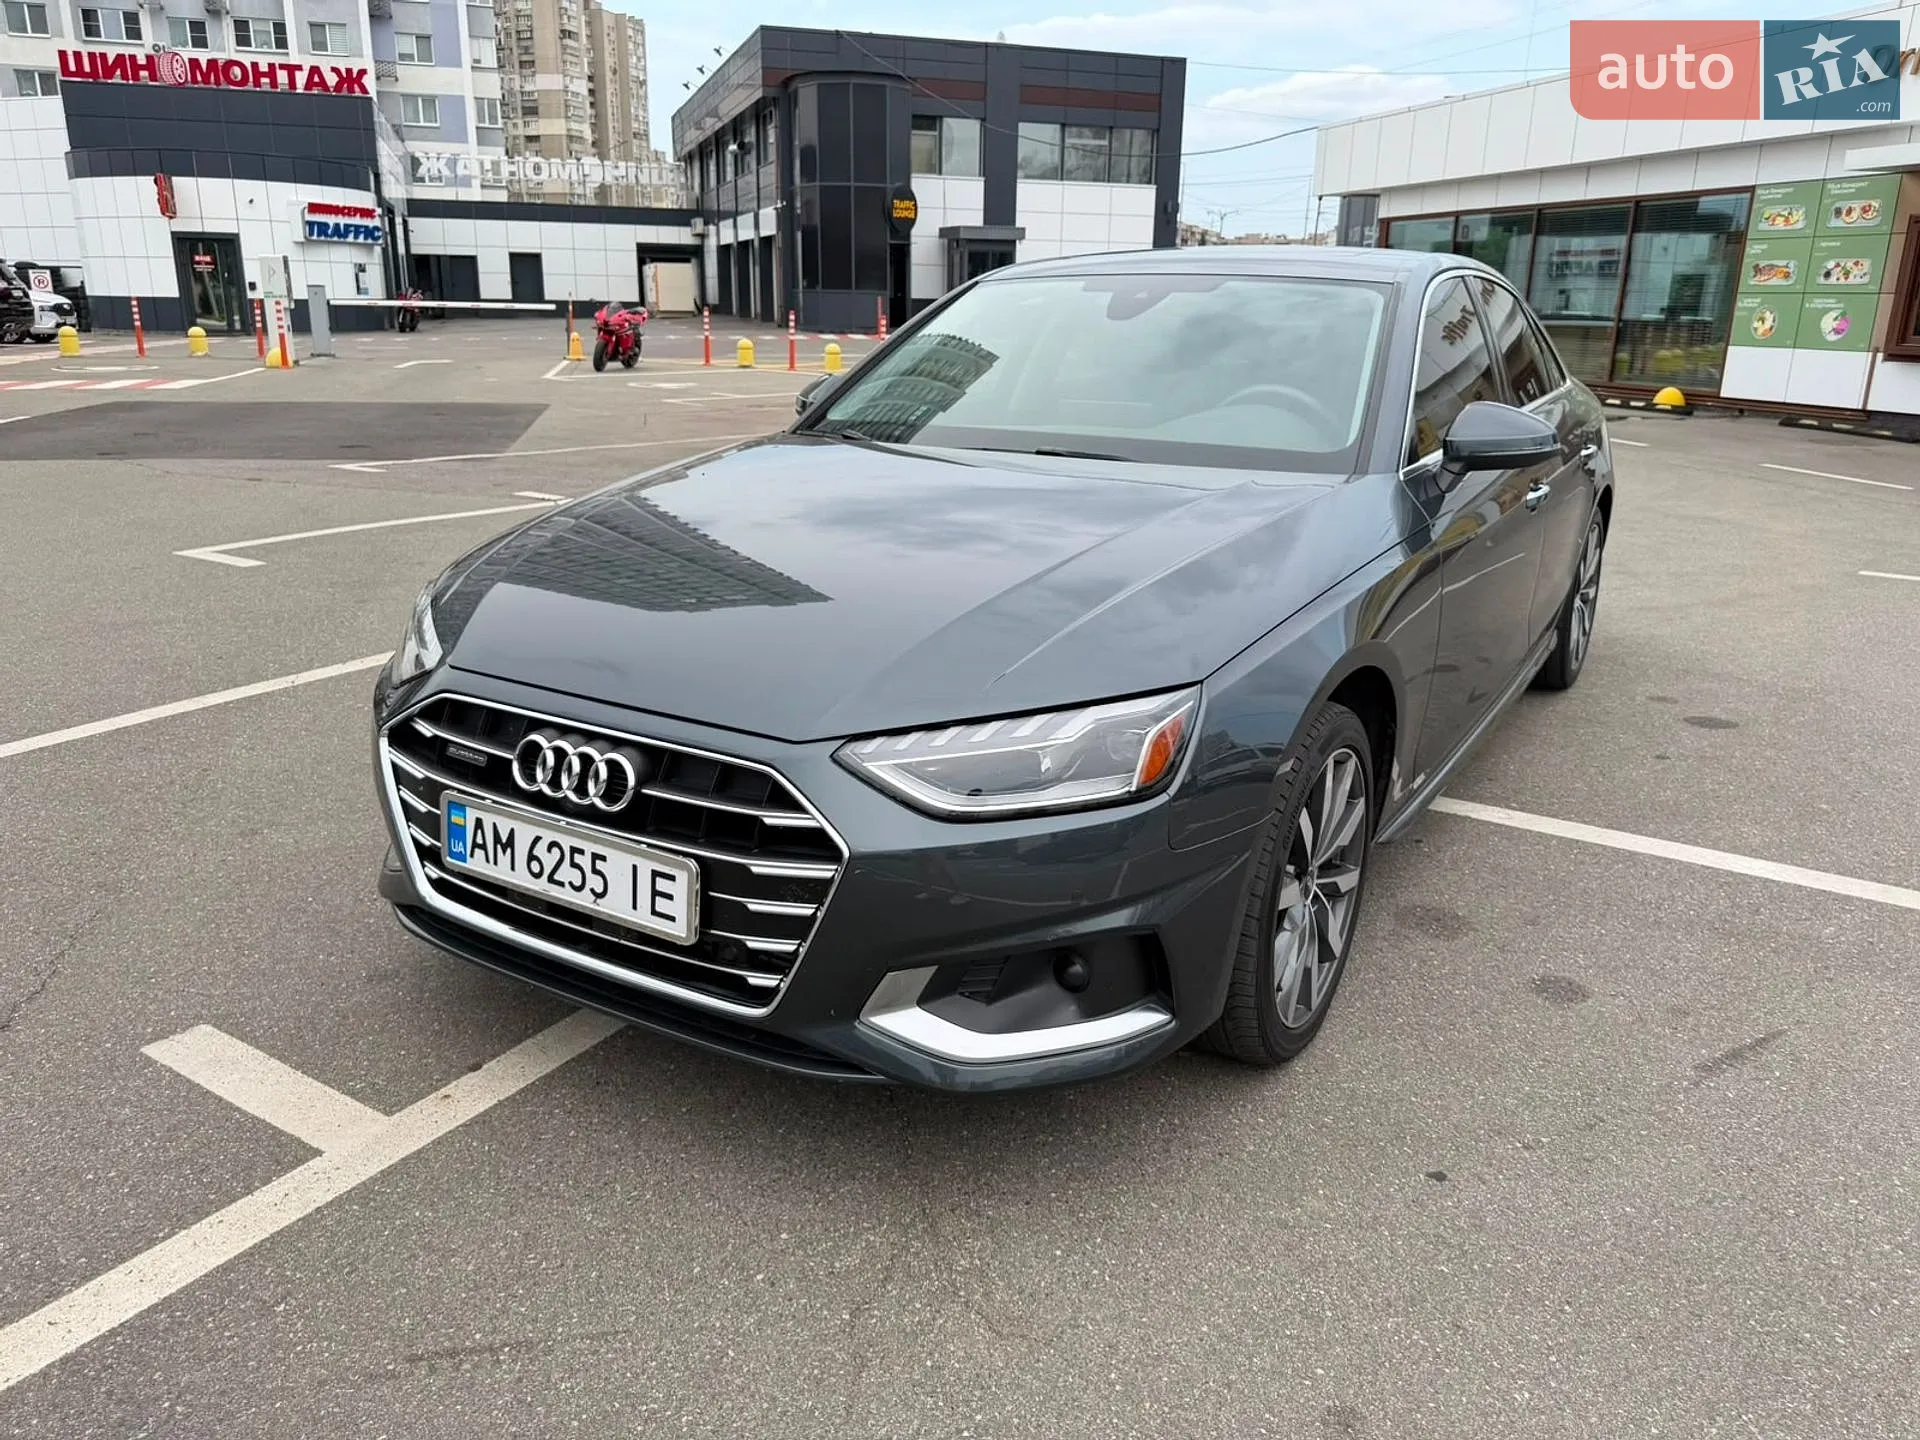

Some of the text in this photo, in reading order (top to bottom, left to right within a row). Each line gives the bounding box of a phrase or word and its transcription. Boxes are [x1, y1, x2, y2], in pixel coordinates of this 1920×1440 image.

[305, 220, 383, 241] TRAFFIC
[451, 841, 466, 855] UA
[469, 817, 677, 923] AM 6255 IE
